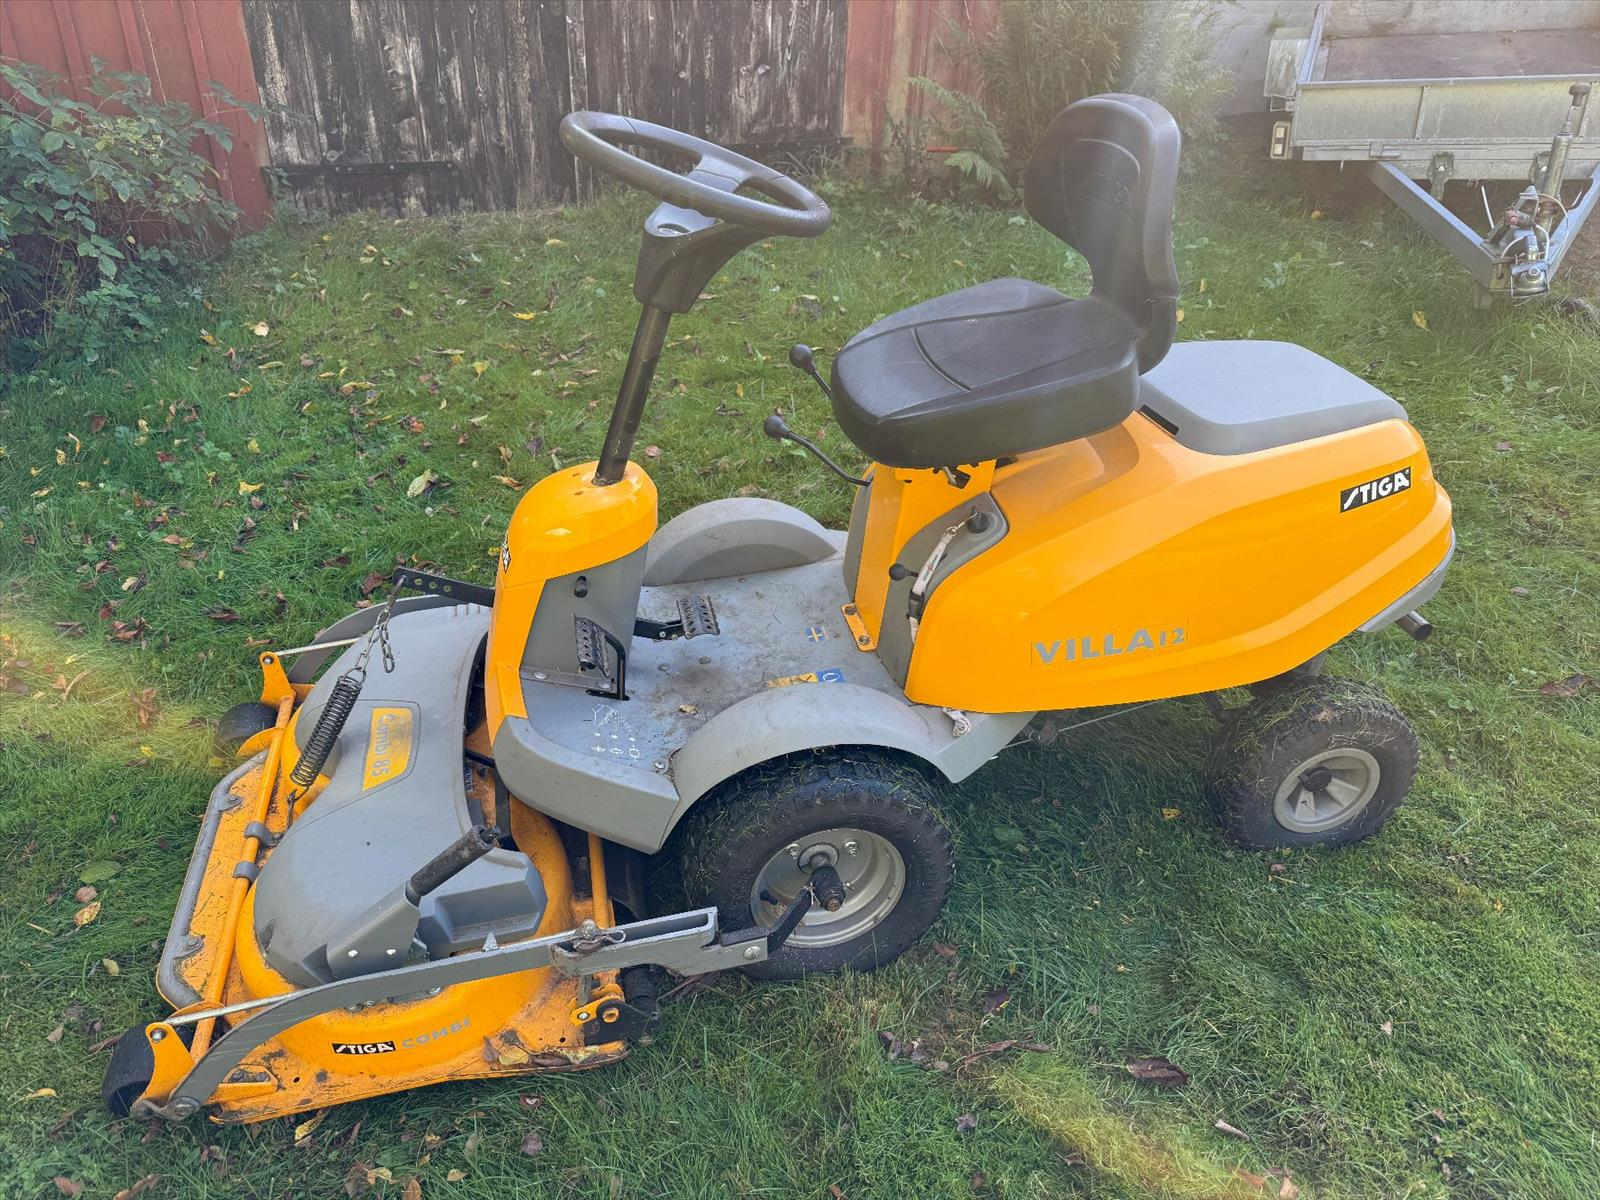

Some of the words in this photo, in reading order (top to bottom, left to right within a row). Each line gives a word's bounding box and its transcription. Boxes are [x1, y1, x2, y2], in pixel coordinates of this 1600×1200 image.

[1343, 469, 1410, 510] STIGA
[1034, 627, 1155, 664] VILLA
[1159, 627, 1185, 648] 12
[371, 759, 391, 778] 85
[335, 1041, 395, 1055] STIGA
[401, 1017, 470, 1049] COMBI
